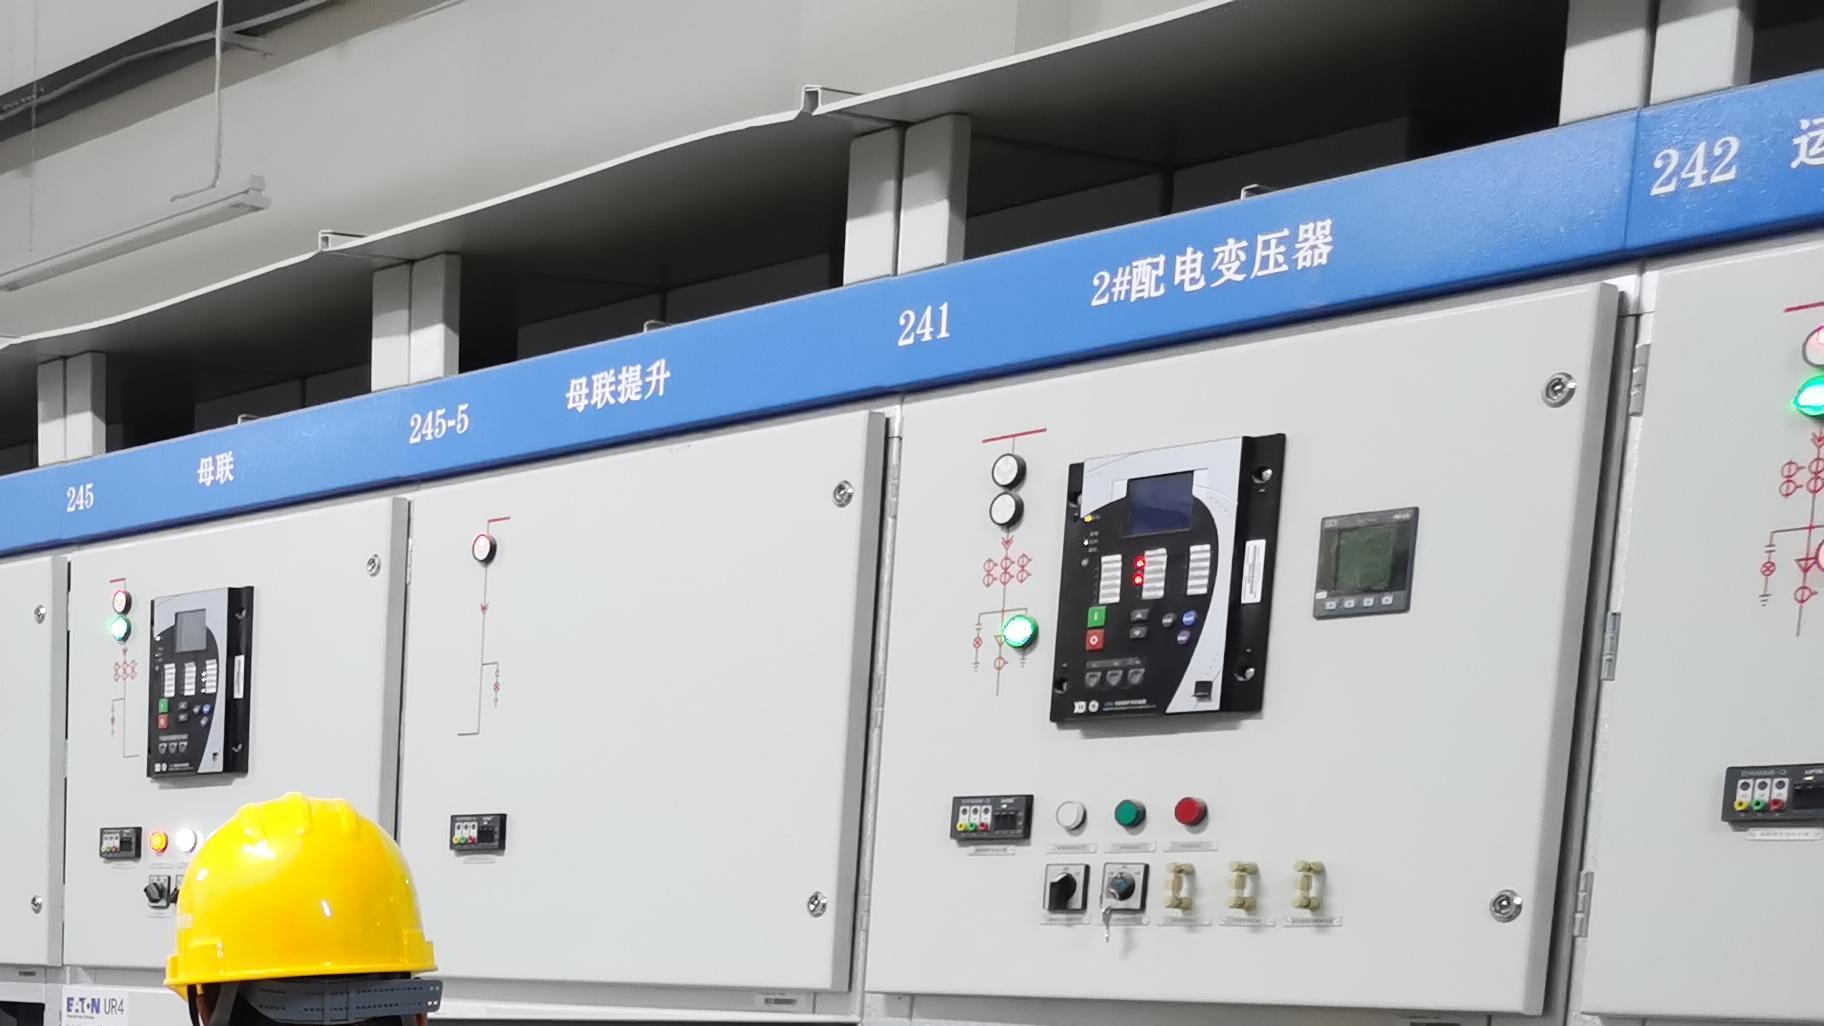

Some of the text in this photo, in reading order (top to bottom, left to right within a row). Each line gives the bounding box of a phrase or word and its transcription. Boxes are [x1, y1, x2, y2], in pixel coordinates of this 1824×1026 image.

[1650, 136, 1741, 197] 242
[897, 218, 1334, 347] 241 2#配电变压器
[408, 358, 671, 445] 245-5 母联提升
[66, 450, 235, 513] 245 母联
[103, 998, 125, 1016] UR4
